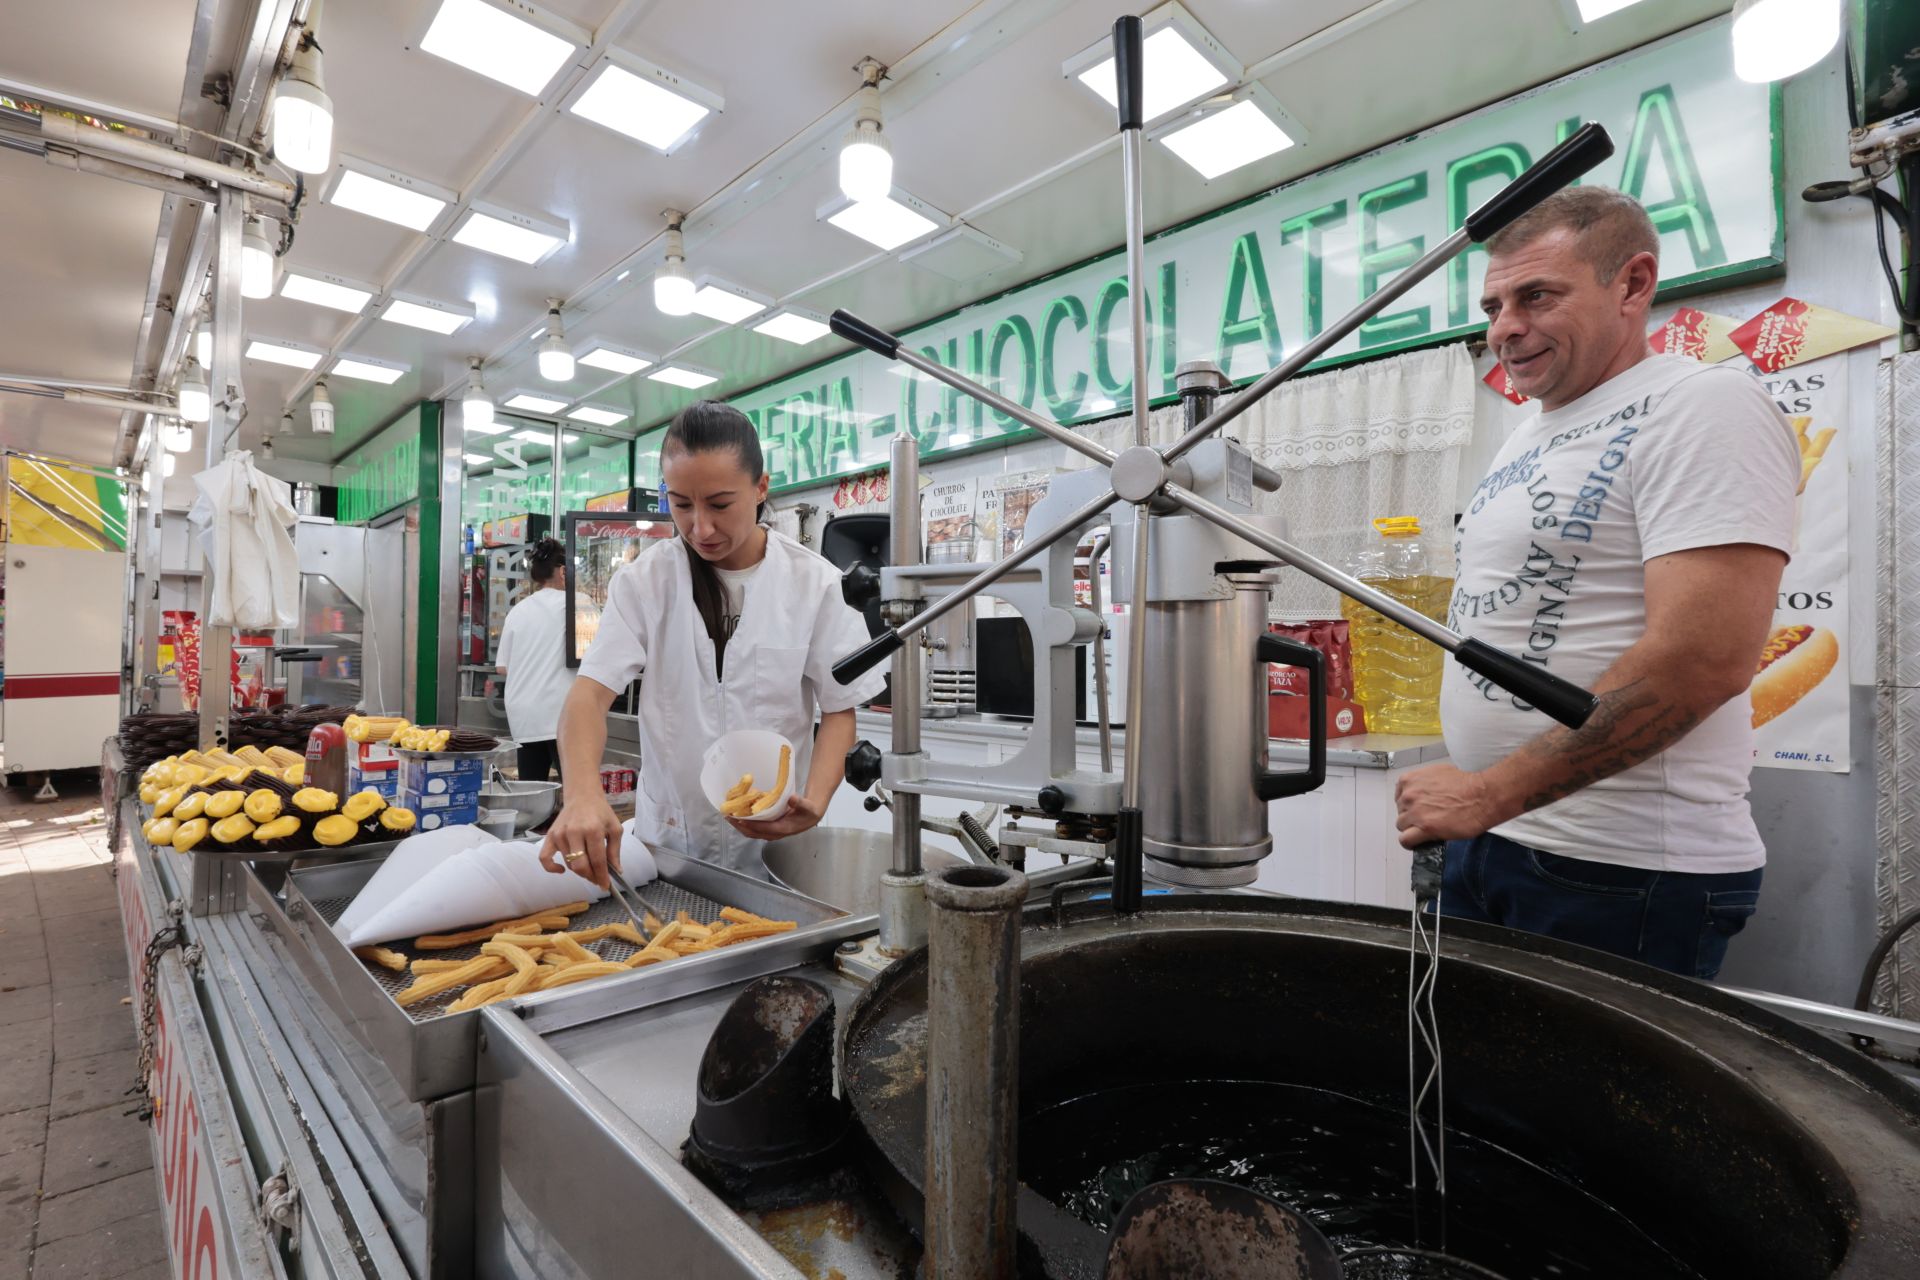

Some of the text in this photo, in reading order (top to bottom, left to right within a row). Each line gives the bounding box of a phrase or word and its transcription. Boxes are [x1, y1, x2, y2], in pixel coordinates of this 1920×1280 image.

[902, 84, 1728, 452] CHOCOLATERA
[1752, 311, 1775, 359] PATATAS
[933, 483, 966, 497] CHURROS
[944, 496, 953, 505] DE
[1527, 474, 1558, 530] LOS
[1561, 424, 1638, 543] DESIGN
[930, 503, 967, 518] CHOCOLATE
[1453, 540, 1555, 618] ANGELES
[1815, 753, 1835, 763] S.L.
